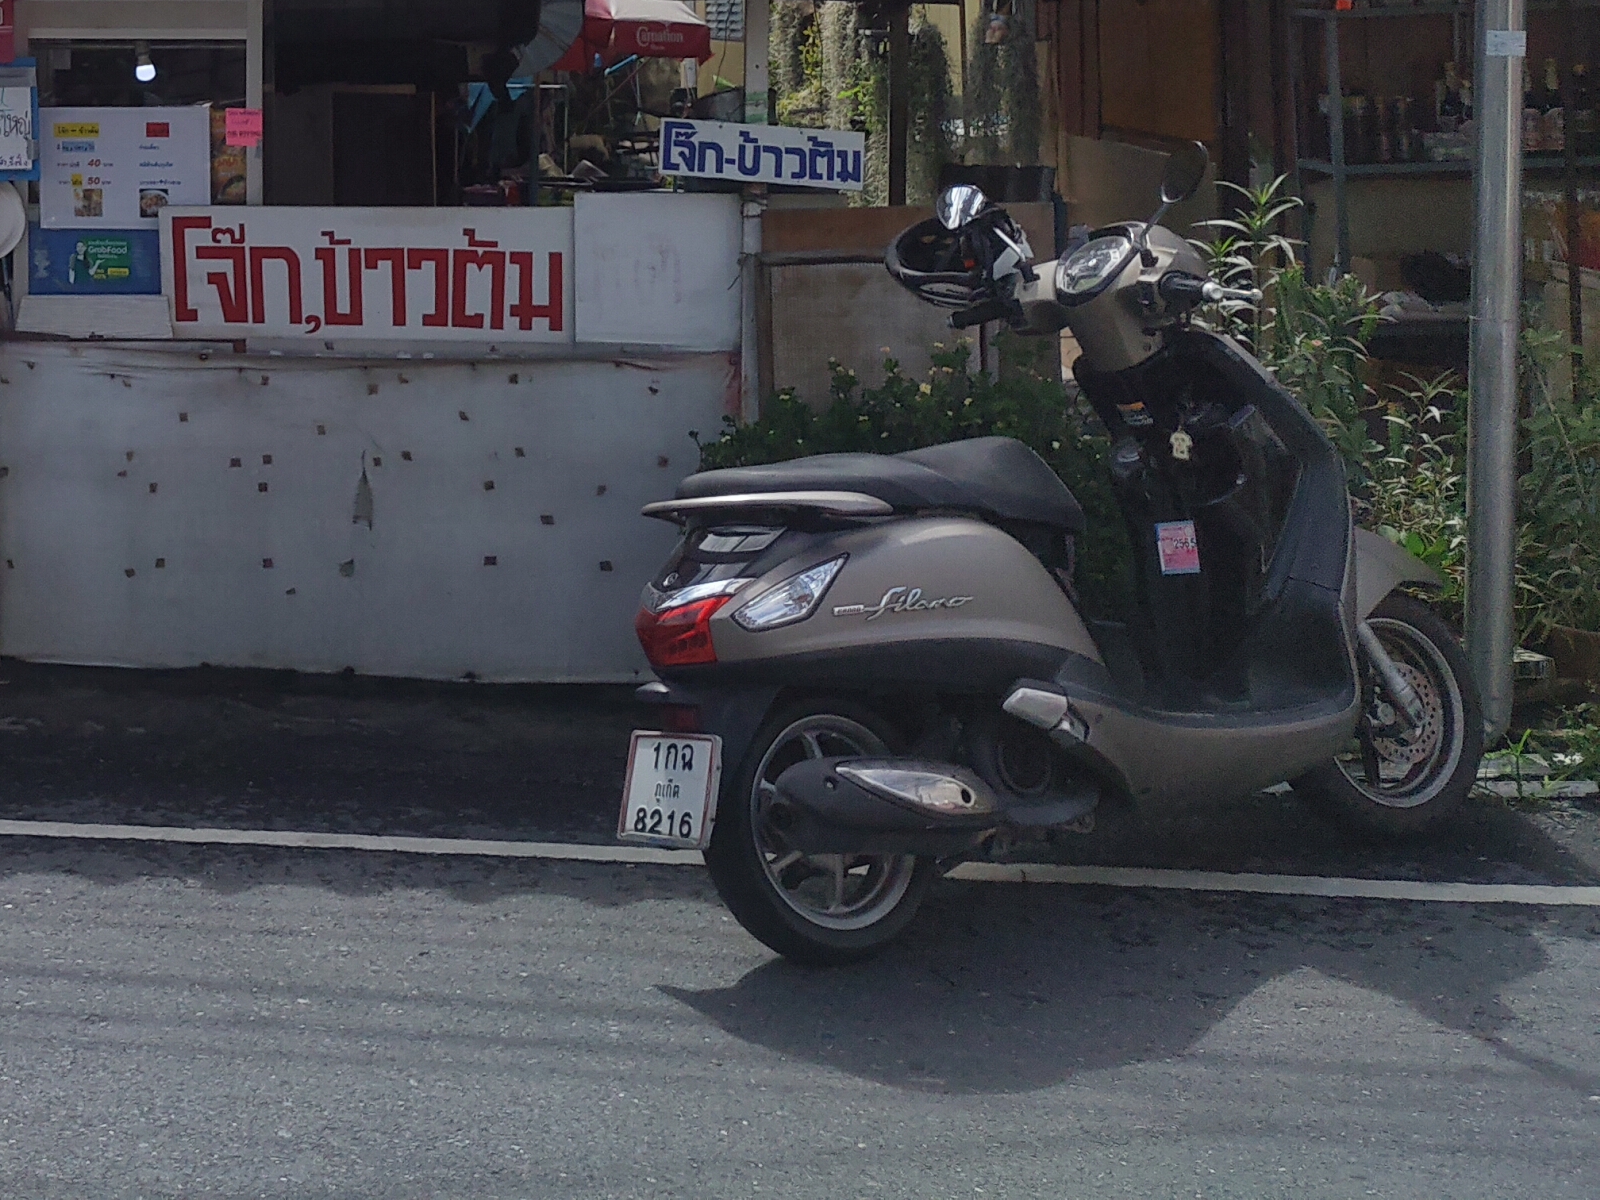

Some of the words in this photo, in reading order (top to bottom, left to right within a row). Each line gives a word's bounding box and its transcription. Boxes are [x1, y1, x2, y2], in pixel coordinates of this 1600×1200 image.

[87, 159, 101, 167] 40
[87, 177, 100, 185] 50
[87, 246, 128, 254] GrabFood
[654, 778, 681, 804] ภูเก็ต
[634, 806, 693, 839] 8216
